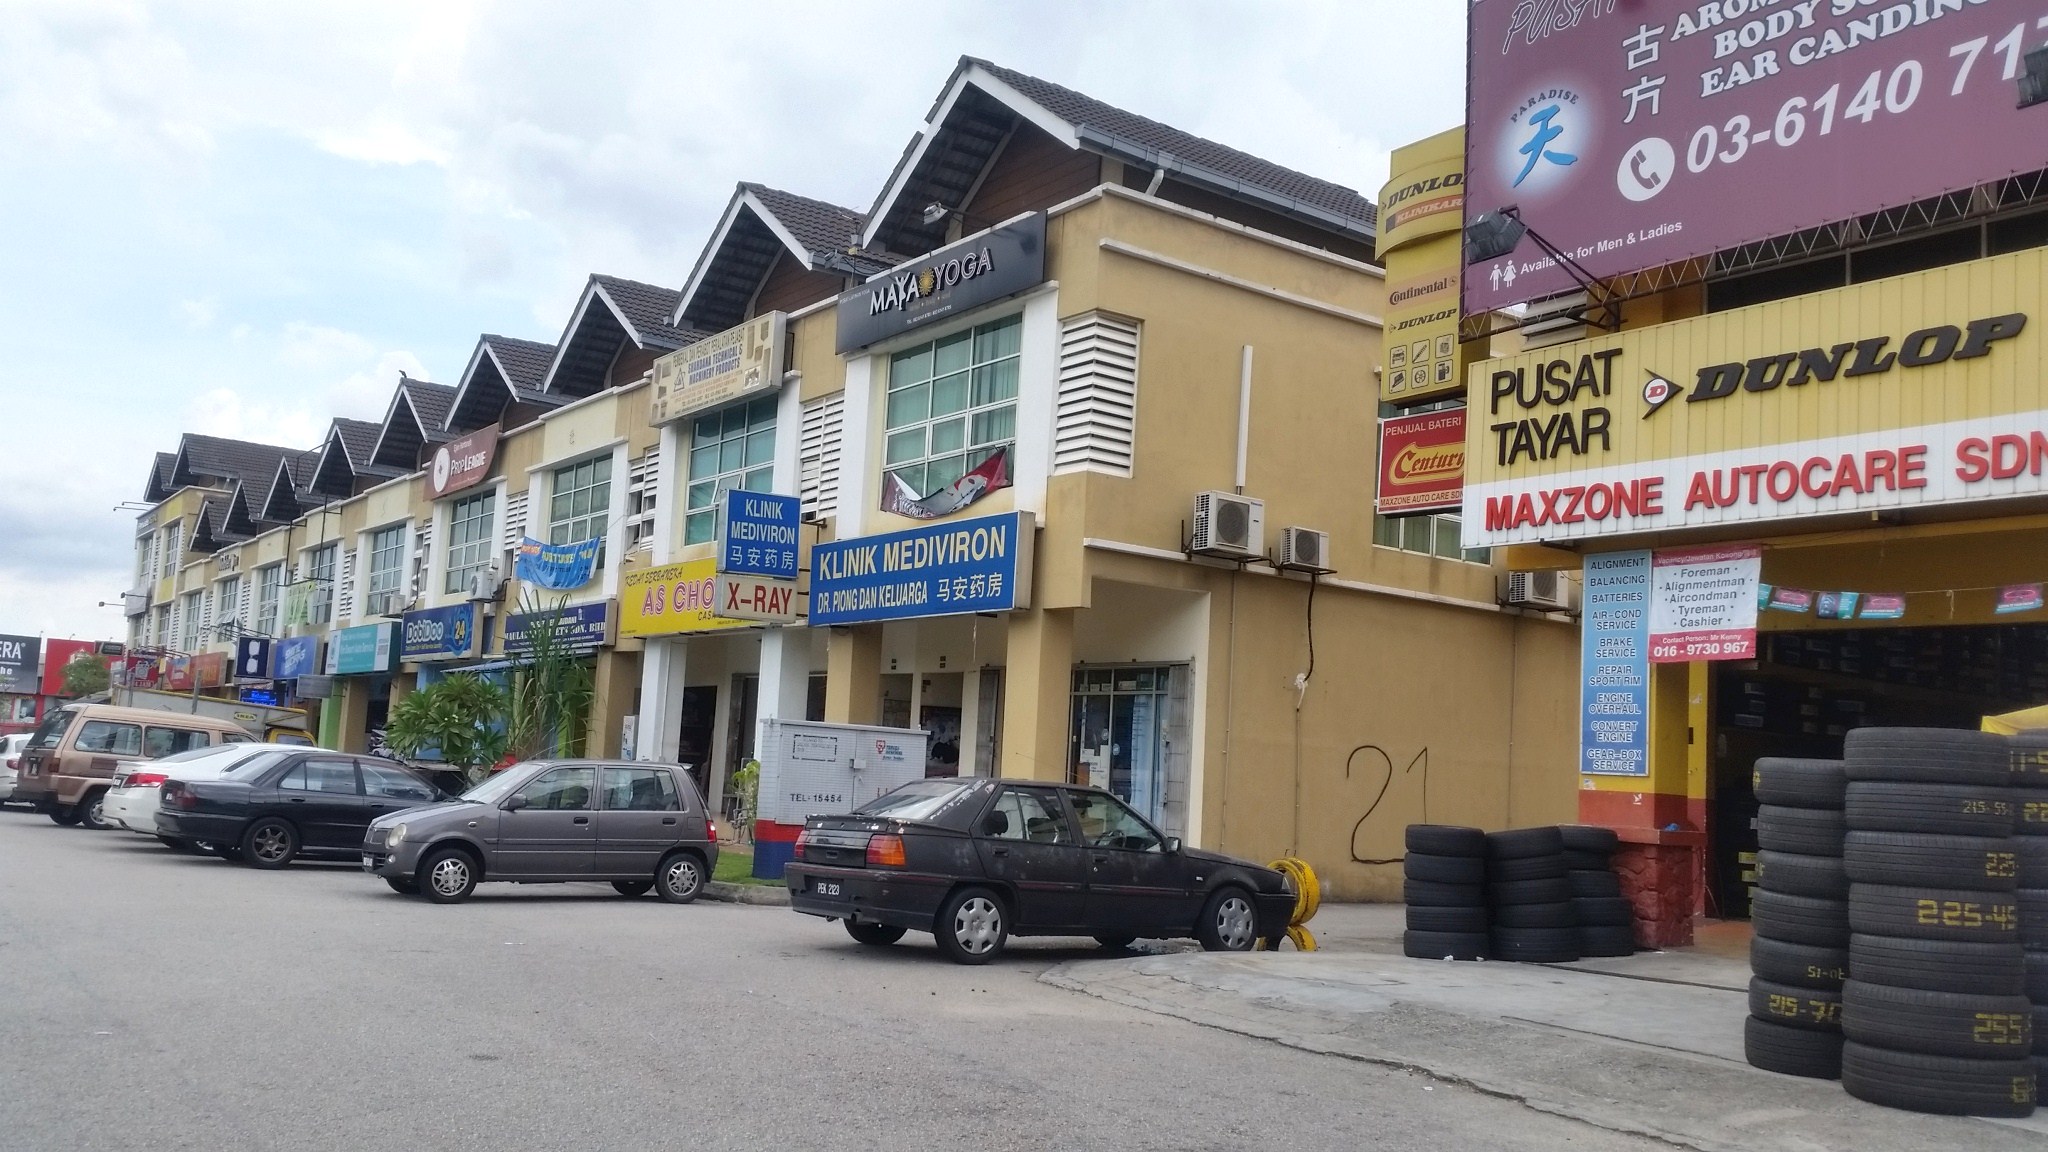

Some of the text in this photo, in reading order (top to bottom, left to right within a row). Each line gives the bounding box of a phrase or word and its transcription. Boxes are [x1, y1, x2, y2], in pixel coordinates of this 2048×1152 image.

[1503, 0, 1615, 54] PUSA
[1713, 0, 1824, 59] BODY
[1700, 0, 1988, 97] EAR CANDIN
[1510, 89, 1579, 124] PARADISE
[1686, 59, 1924, 174] 03-6140
[1387, 172, 1464, 209] DUNLO
[1520, 222, 1683, 275] Available for Men & Ladies
[869, 270, 920, 316] MAYA
[934, 247, 993, 290] YOGA
[1389, 277, 1448, 306] Continental
[1397, 308, 1457, 331] DUNLOP
[1685, 312, 2028, 403] DUNLOP
[1490, 347, 1623, 415] PUSAT
[1385, 416, 1462, 437] PENJUAL BATERI
[1490, 406, 1611, 467] TAYAR
[1394, 450, 1465, 480] Century
[1484, 475, 1665, 533] MAXZONE
[1682, 444, 1928, 512] AUTOCARE
[1380, 495, 1412, 507] MAXZONE
[1412, 493, 1430, 503] AUTO
[1431, 491, 1449, 501] CARE
[745, 499, 783, 520] KLINIK
[731, 521, 795, 545] MEDIVIRON
[730, 545, 794, 570] 马安药房
[819, 525, 1006, 581] KLINIK MEDIVIRON
[1591, 558, 1646, 570] ALIGNMENT
[1680, 566, 1730, 578] Foreman
[936, 572, 1003, 603] 马安药房
[1590, 575, 1645, 587] BALANCING
[1664, 577, 1745, 593] Alignmentman
[641, 584, 666, 617] AS
[726, 581, 793, 615] X-RAY
[817, 580, 928, 614] DR. PIONG DAN KELUARGA
[1591, 592, 1643, 603] BATTERIES
[1669, 591, 1737, 604] Aircondman
[1592, 609, 1642, 620] AIR-COND
[1678, 604, 1726, 617] Tyreman
[455, 620, 466, 640] 24
[1596, 620, 1637, 631] SERVICE
[1680, 616, 1723, 628] Cashier
[1599, 638, 1633, 647] BRAKE
[1662, 636, 1684, 644] Contact
[1720, 633, 1742, 642] Kenny
[1595, 649, 1636, 658] SERVICE
[1653, 645, 1677, 657] 016
[1686, 643, 1720, 656] 9730
[1723, 641, 1749, 653] 967
[1598, 665, 1632, 675] REPAIR
[1589, 676, 1641, 686] SPORT RIM
[1596, 693, 1633, 703] ENGINE
[1588, 704, 1641, 714] OVERHAUL
[1591, 721, 1638, 731] CONVERT
[1596, 732, 1633, 742] ENGINE
[1587, 749, 1642, 760] GEAR-BOX
[1592, 761, 1635, 771] SERVICE
[813, 794, 842, 803] 15454
